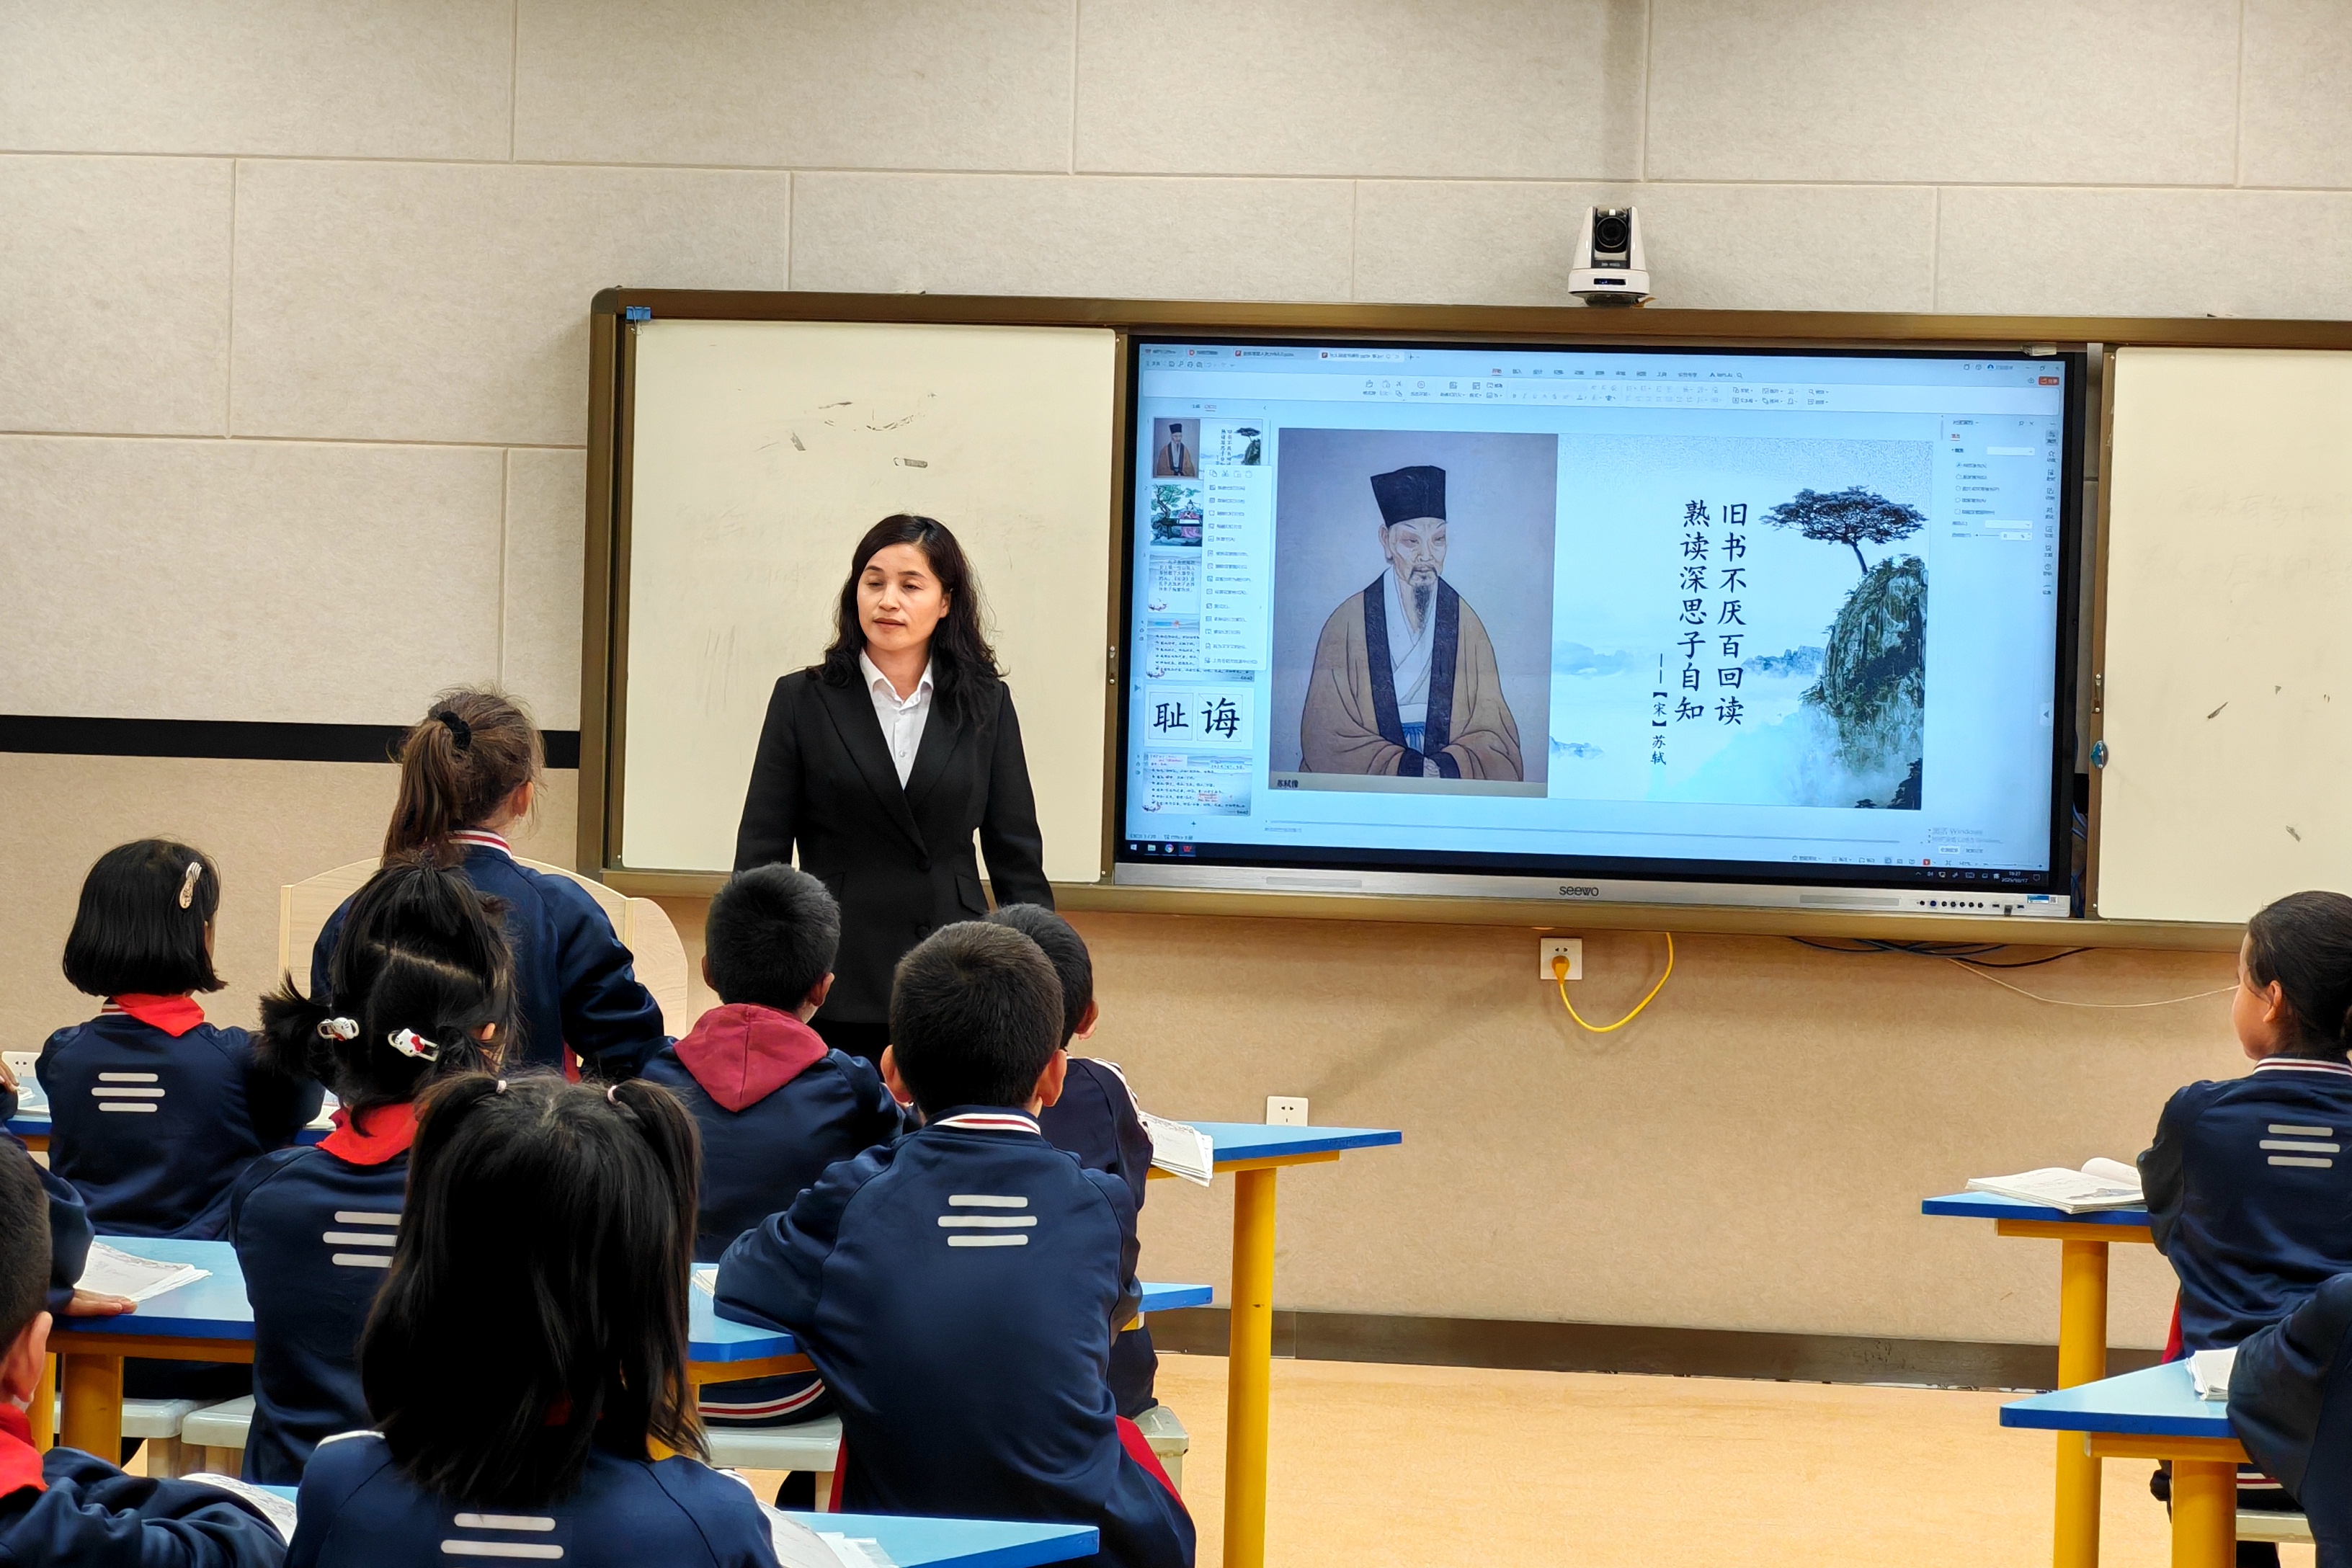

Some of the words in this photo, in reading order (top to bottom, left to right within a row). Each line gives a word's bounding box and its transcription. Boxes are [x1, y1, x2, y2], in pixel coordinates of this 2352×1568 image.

[1673, 499, 1711, 723] 熟读深思子自知
[1714, 502, 1748, 726] 旧书不厌百回读
[1559, 886, 1600, 896] seewo
